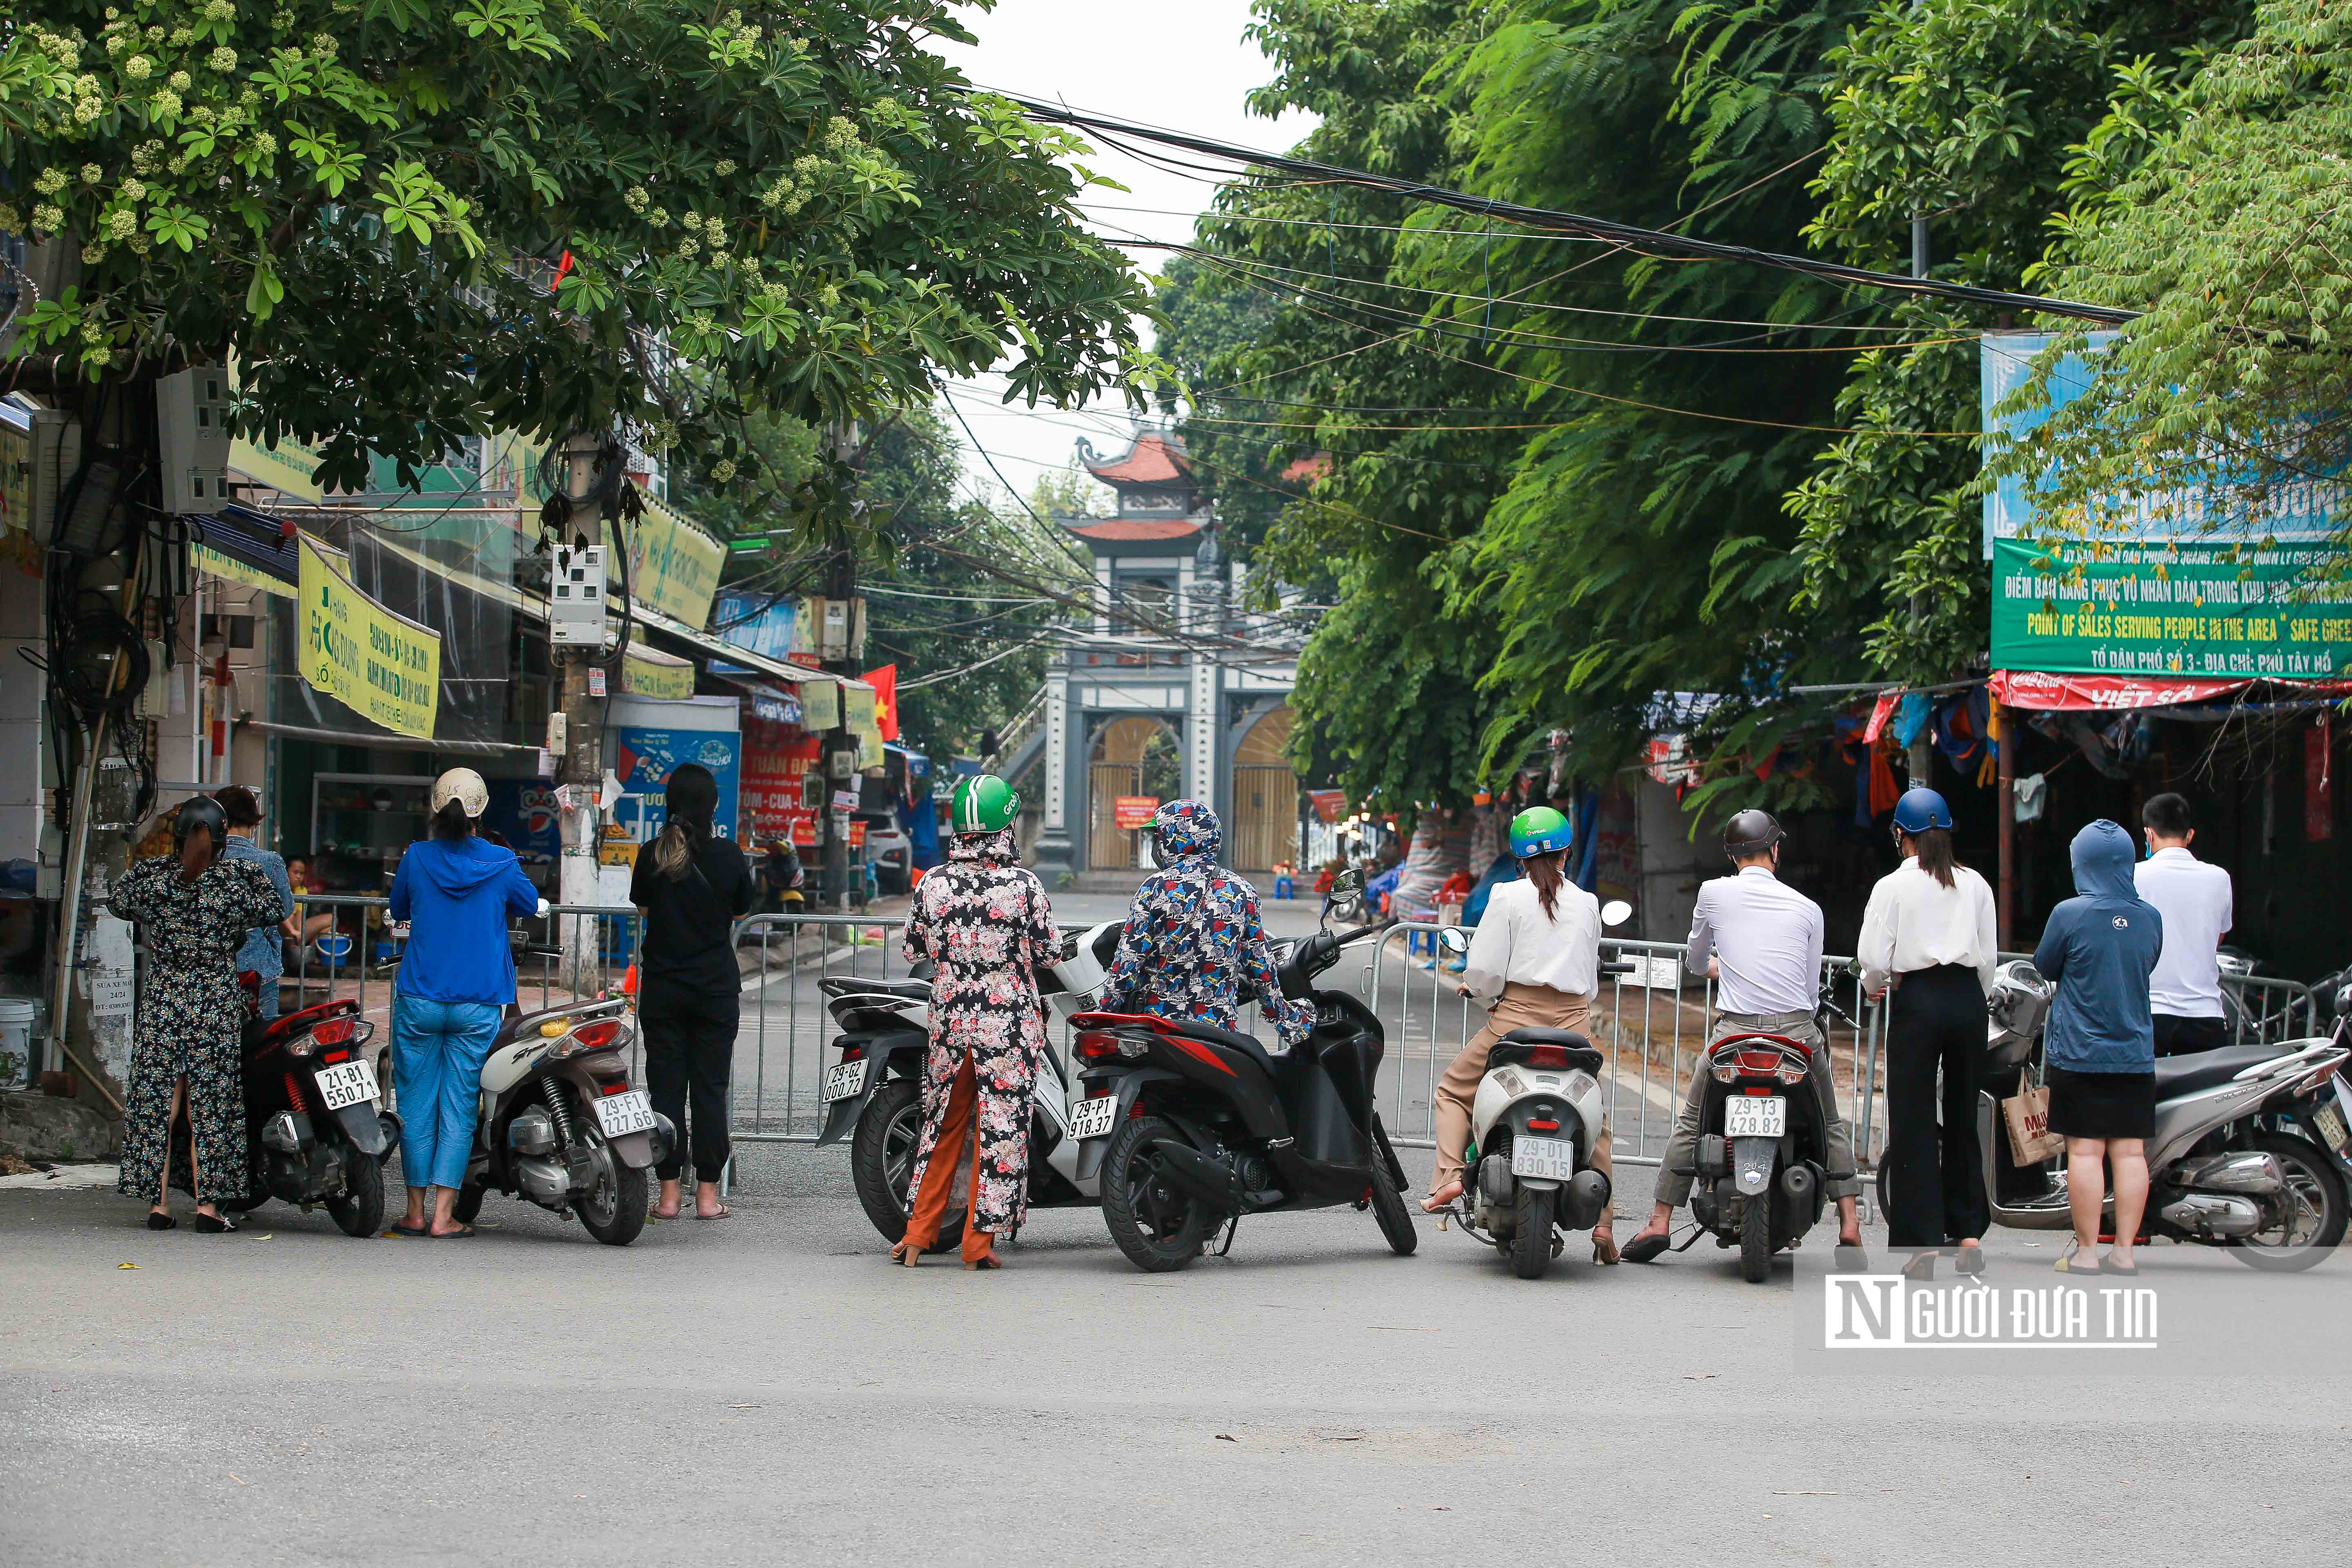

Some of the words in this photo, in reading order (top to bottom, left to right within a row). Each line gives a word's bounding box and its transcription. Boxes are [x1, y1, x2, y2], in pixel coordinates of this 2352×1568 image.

[2005, 568, 2031, 599] ĐIỂM
[2175, 575, 2197, 603] DÂN
[2201, 580, 2238, 604] TRONG
[2241, 580, 2265, 605] KHU
[2028, 612, 2058, 636] POINT
[2062, 614, 2075, 637] OF
[2078, 614, 2111, 637] SALES
[2114, 615, 2161, 639] SERVING
[2165, 617, 2206, 640] PEOPLE
[2209, 617, 2221, 641] IN
[2224, 617, 2244, 641] THE
[2247, 618, 2277, 641] AREA
[2290, 618, 2319, 642] SAFE
[2091, 644, 2107, 668] TỔ
[2109, 647, 2135, 669] DÂN
[2138, 645, 2163, 670] PHỐ
[2186, 654, 2194, 670] 3
[2205, 653, 2226, 675] ĐỊA
[2229, 648, 2254, 672] CHỈ:
[2258, 648, 2283, 673] PHỦ
[2287, 650, 2310, 673] TÂY
[1003, 793, 1017, 815] Grab
[325, 1065, 363, 1089] 21-B1
[833, 1062, 862, 1079] 29-G2
[327, 1081, 376, 1106] 550.71
[824, 1078, 860, 1100] 000.72
[602, 1094, 641, 1116] 29-F1
[1079, 1099, 1109, 1119] 29-P1
[1735, 1099, 1777, 1116] 29-Y3
[604, 1110, 652, 1135] 227.66
[1069, 1115, 1110, 1137] 918.37
[1730, 1117, 1781, 1134] 428.82
[1522, 1140, 1564, 1158] 29-D1
[1517, 1157, 1568, 1178] 830.15
[1743, 1162, 1767, 1172] 204
